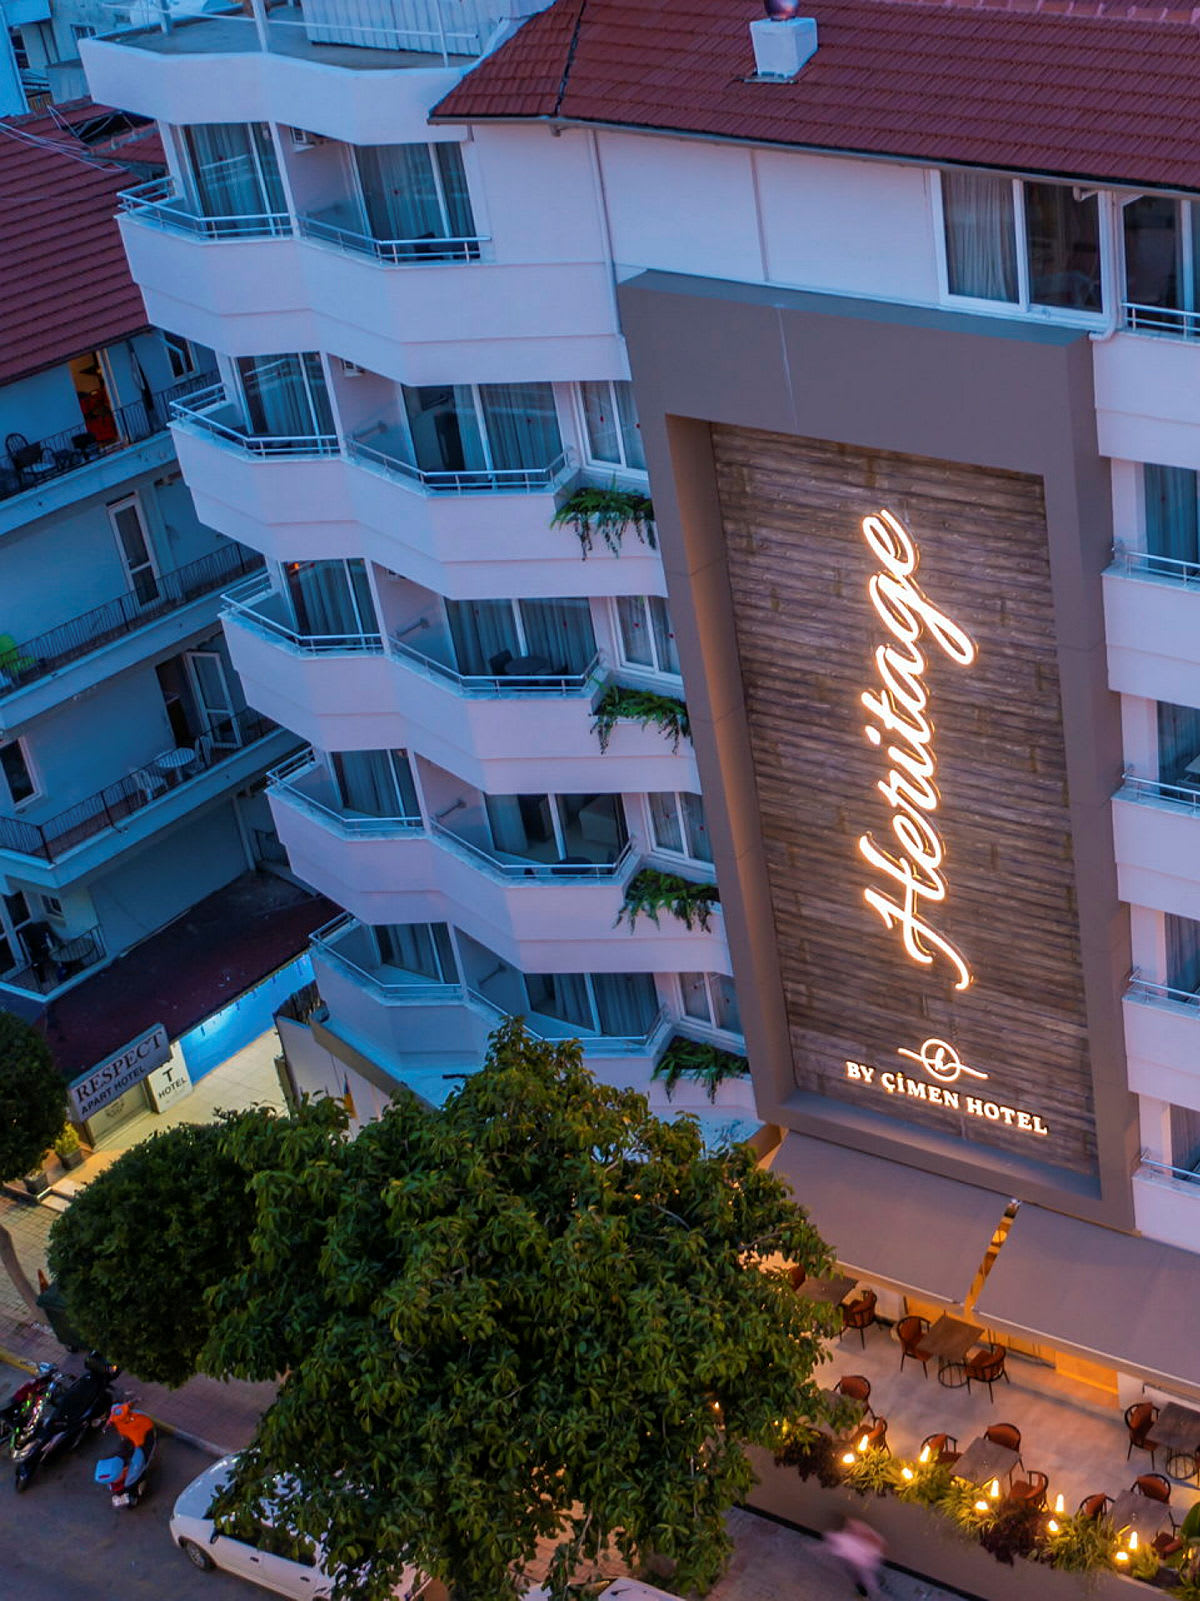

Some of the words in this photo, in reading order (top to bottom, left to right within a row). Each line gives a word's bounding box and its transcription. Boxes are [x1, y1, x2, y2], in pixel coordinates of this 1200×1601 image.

[859, 508, 977, 991] Heritage
[76, 1031, 163, 1102] RESPECT
[81, 1086, 113, 1115] APART
[114, 1065, 145, 1093] HOTEL
[158, 1076, 187, 1099] HOTEL
[846, 1060, 875, 1084] BY
[881, 1071, 960, 1110] ÇİMEN
[966, 1096, 1049, 1136] HOTEL
